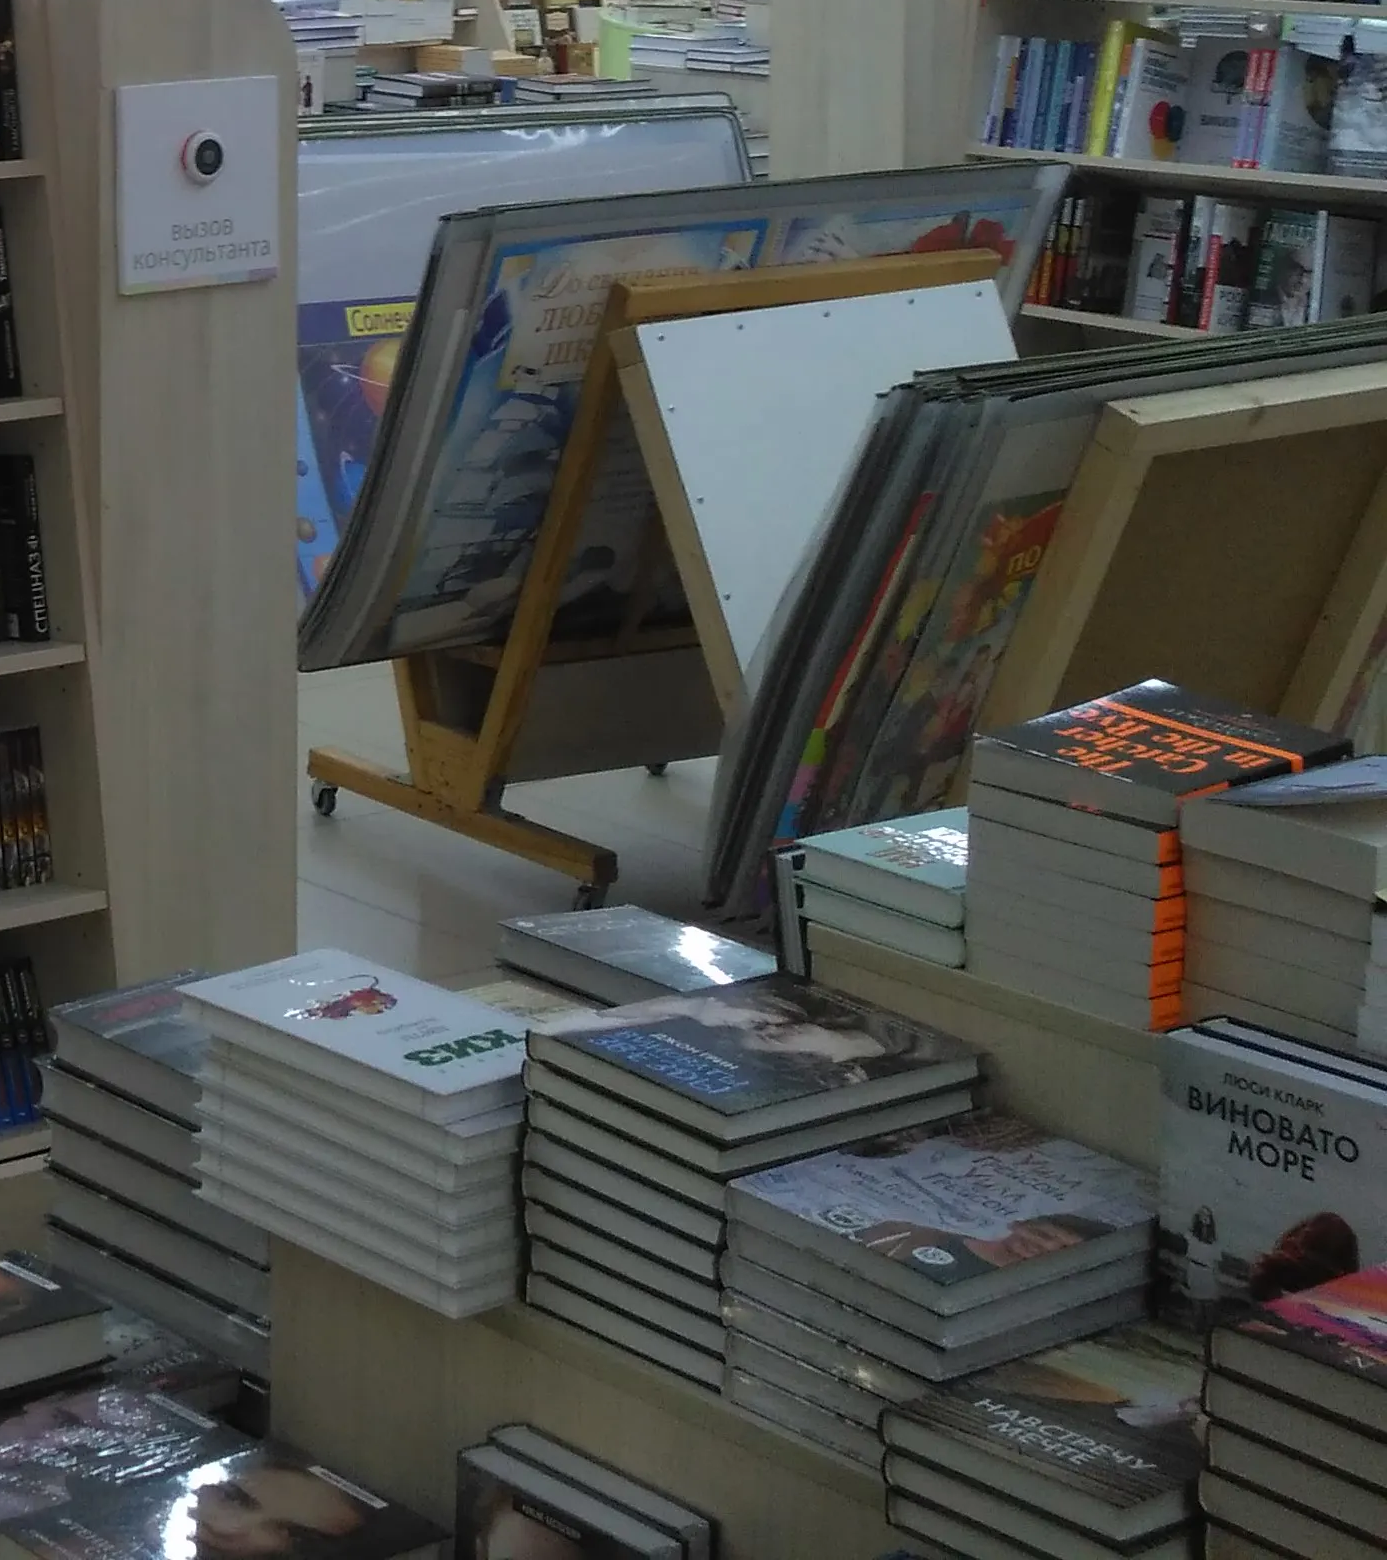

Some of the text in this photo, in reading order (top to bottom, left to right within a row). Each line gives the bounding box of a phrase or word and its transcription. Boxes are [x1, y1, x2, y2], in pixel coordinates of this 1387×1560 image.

[133, 239, 271, 271] консультанта
[1052, 726, 1209, 774] Catcher
[1056, 743, 1134, 773] The
[1150, 732, 1222, 755] the
[1222, 1071, 1325, 1116] ЛЮСИ КЛАРК
[1185, 1085, 1361, 1164] ВИНОВАТО
[1226, 1129, 1318, 1184] МОРЕ
[973, 1397, 1158, 1472] НАВСТРЕЧУ
[988, 1422, 1095, 1467] МЕЧТЕ
